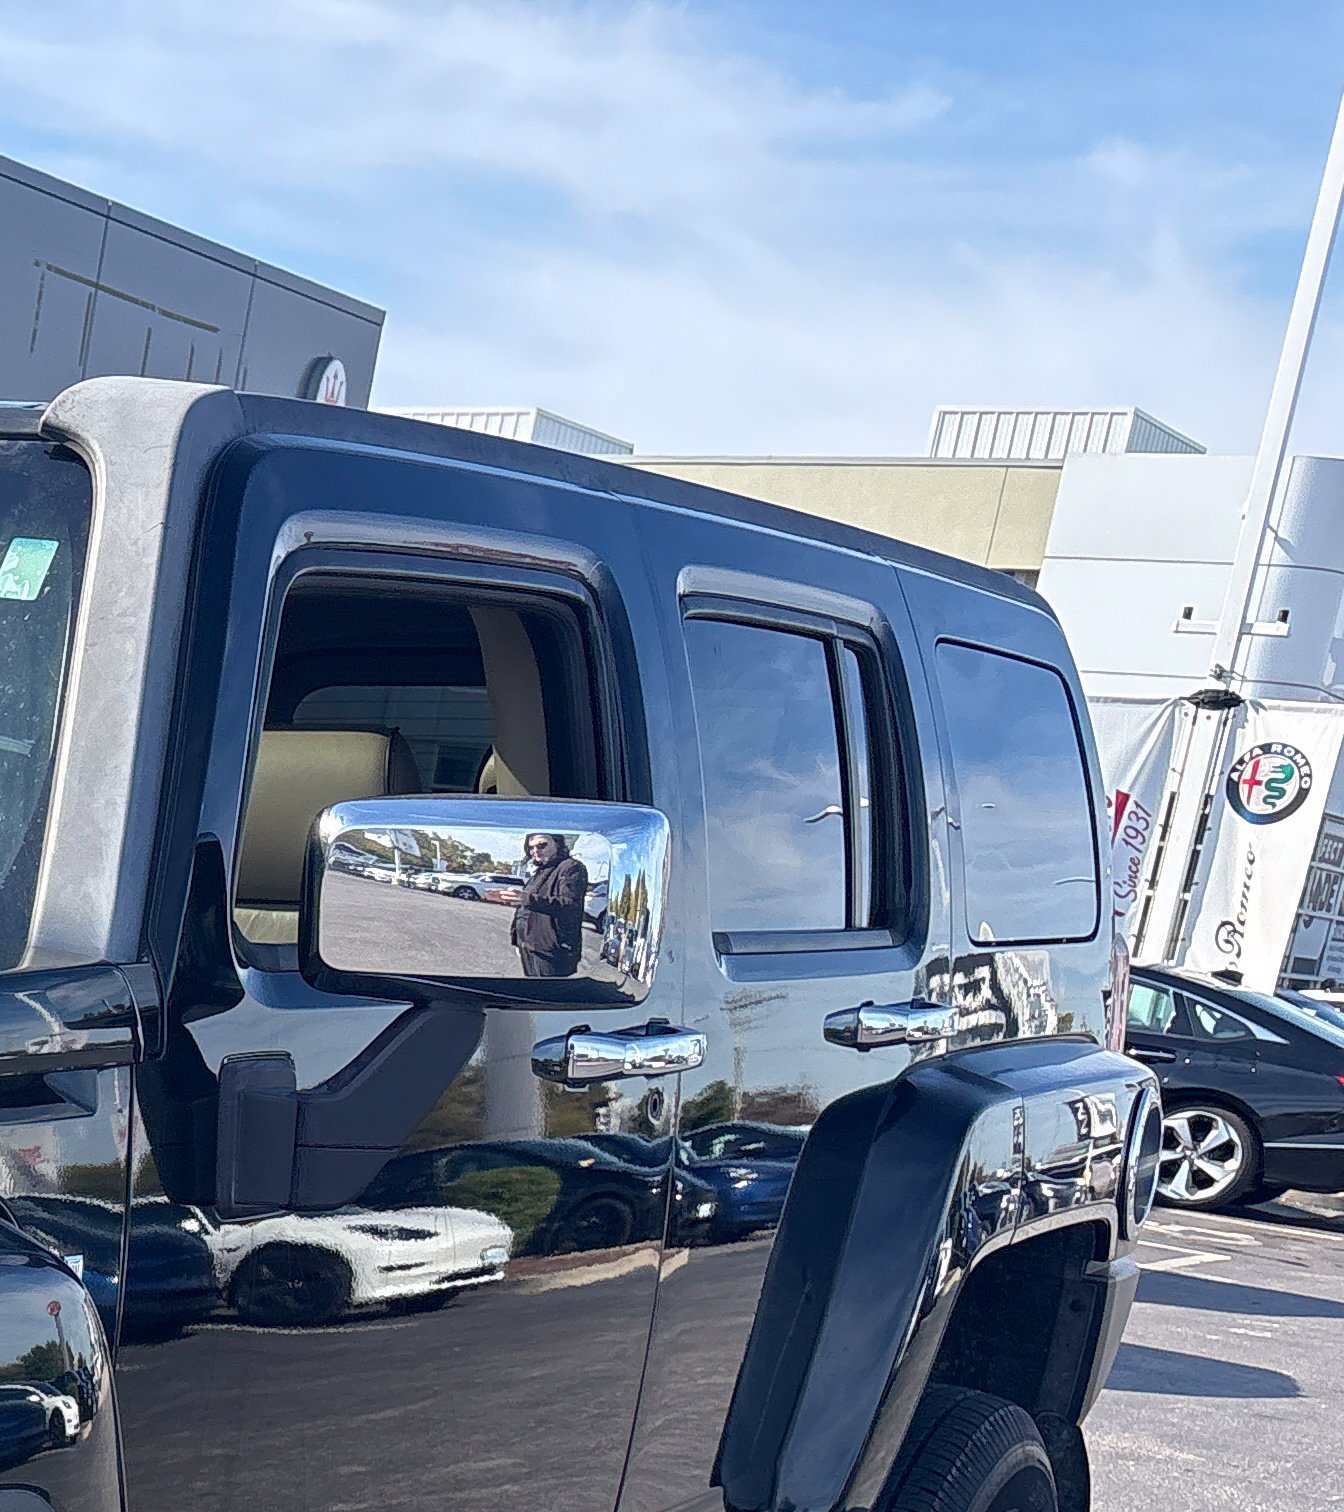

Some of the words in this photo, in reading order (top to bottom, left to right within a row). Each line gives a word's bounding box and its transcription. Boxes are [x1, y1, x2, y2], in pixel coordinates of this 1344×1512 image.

[1230, 747, 1264, 783] ALFA
[1270, 743, 1312, 789] ROMEO
[1122, 799, 1152, 854] 1931
[1113, 856, 1141, 903] Since
